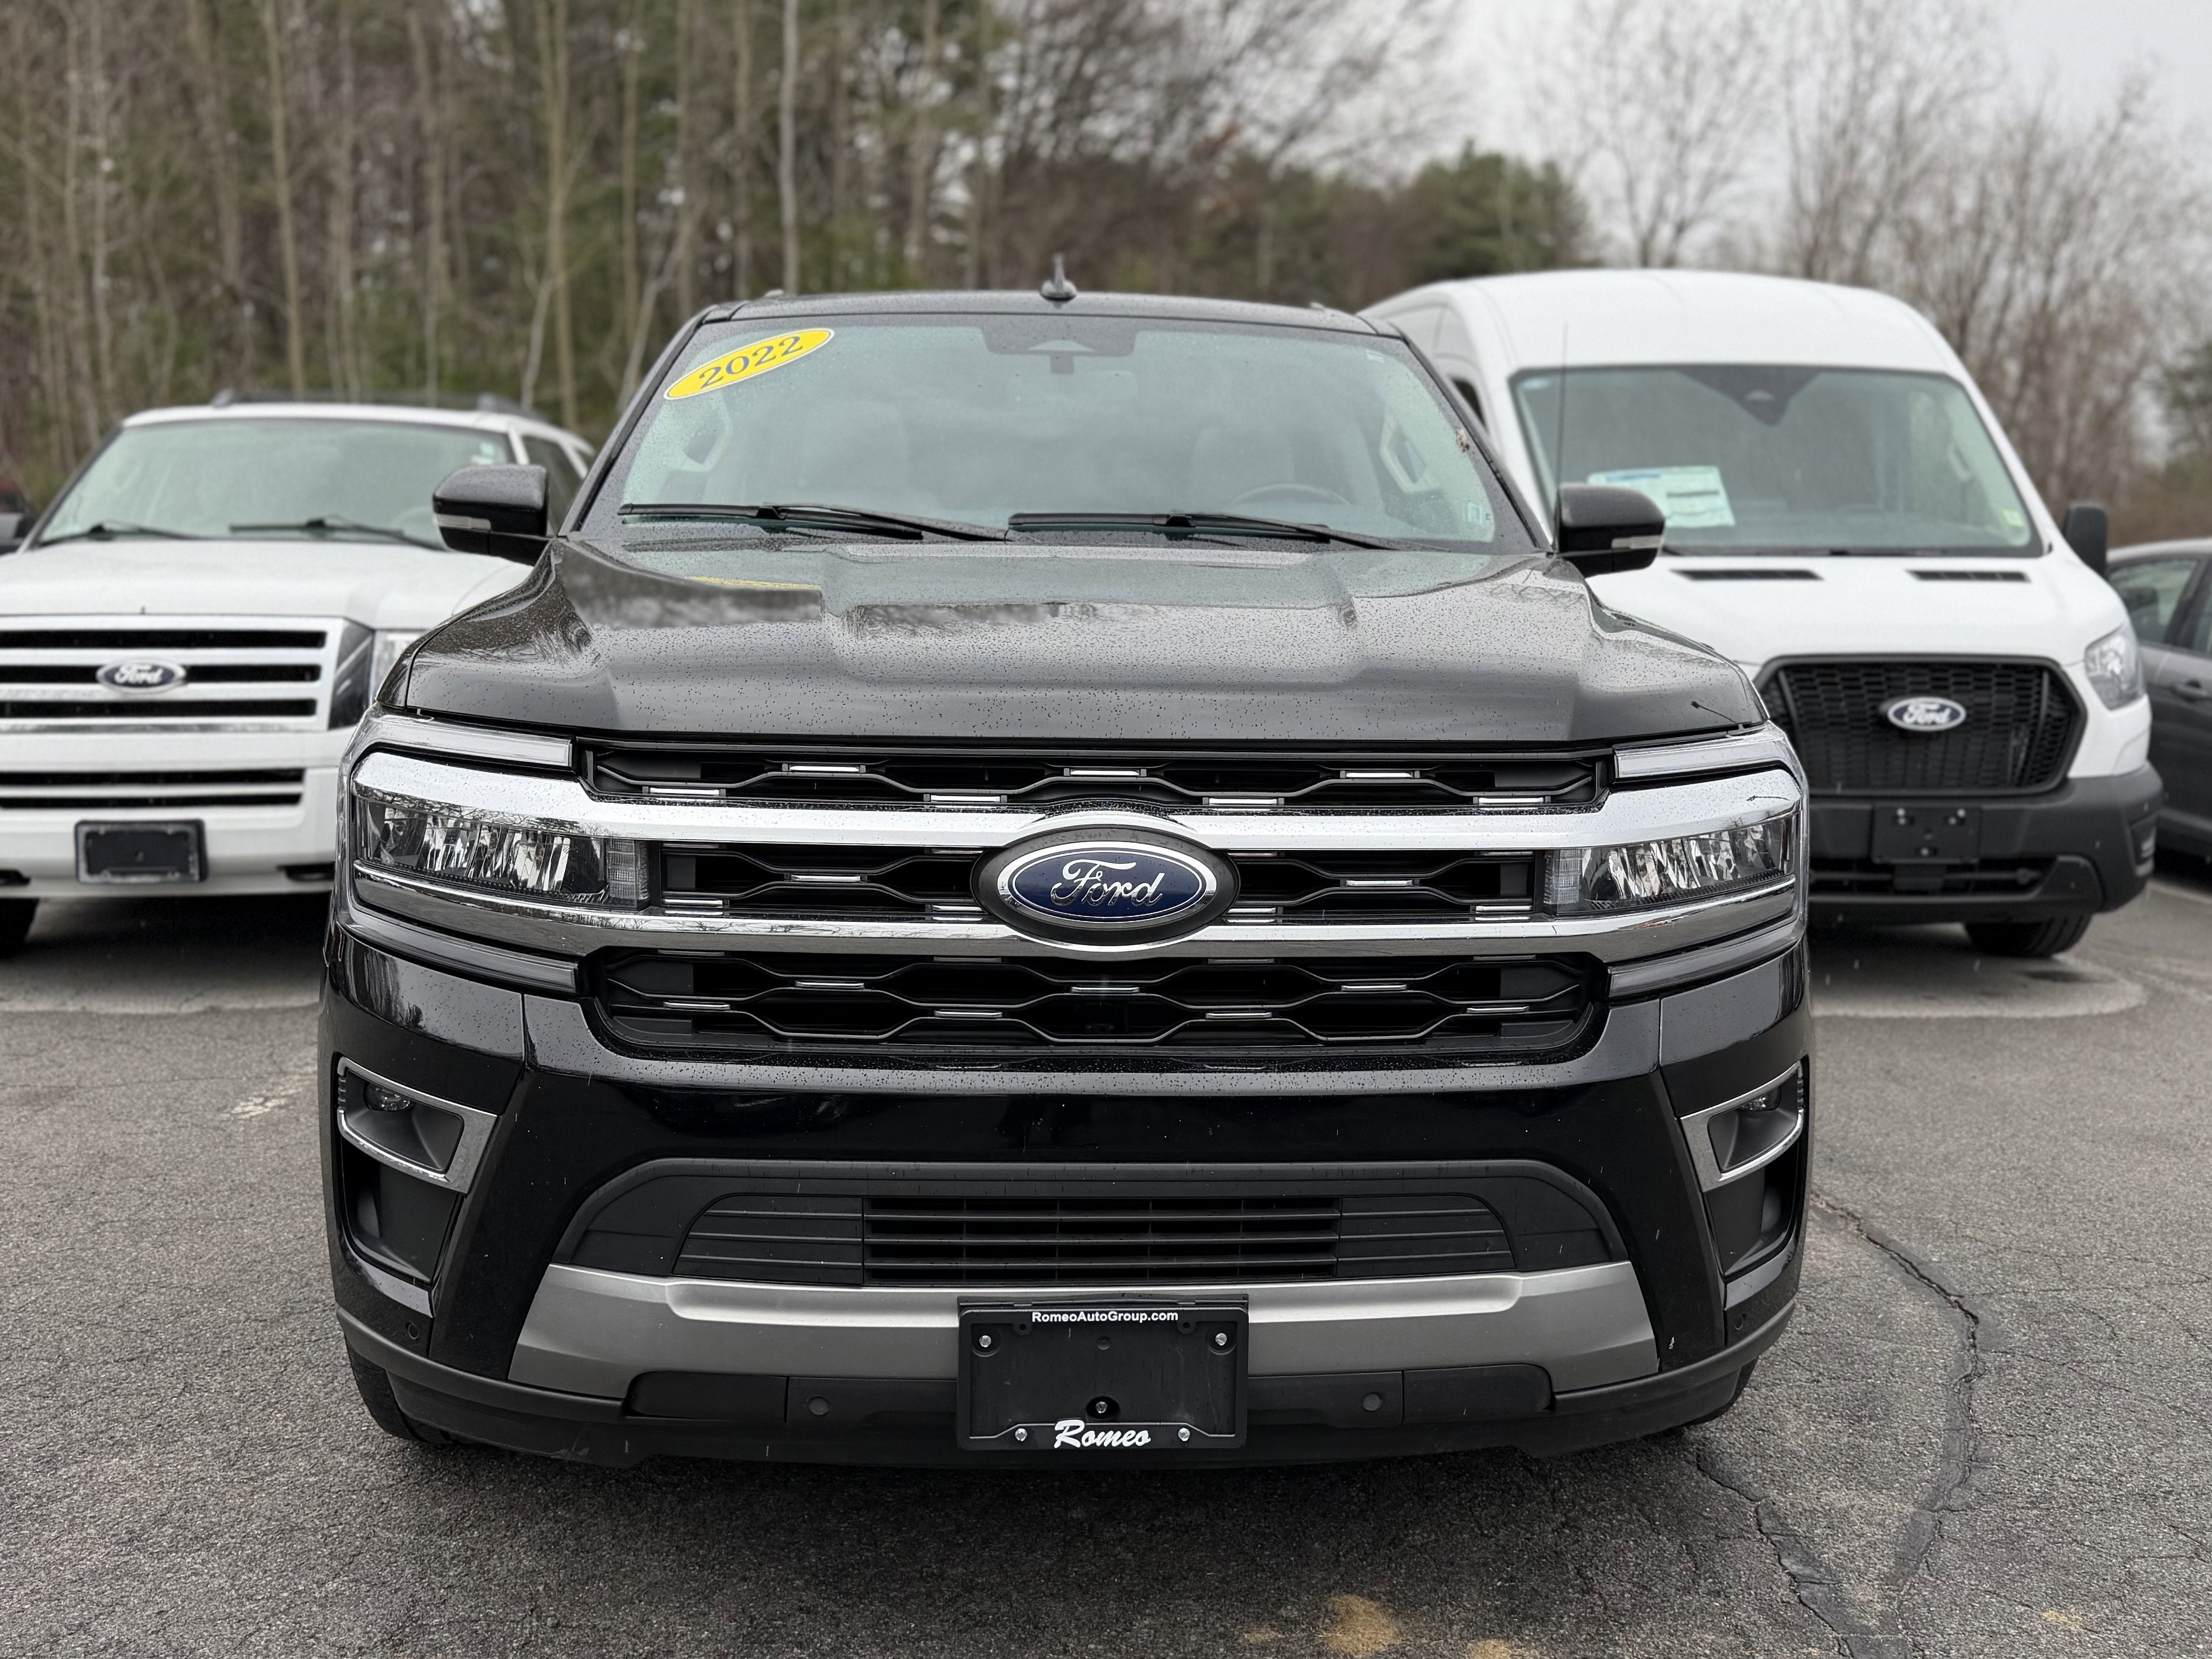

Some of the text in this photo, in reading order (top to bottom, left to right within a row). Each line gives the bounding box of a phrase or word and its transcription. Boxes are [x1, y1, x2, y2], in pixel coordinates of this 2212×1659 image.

[699, 336, 803, 389] 2022
[114, 662, 164, 685] Ford
[1902, 704, 1951, 725] Ford
[1051, 859, 1165, 906] Ford
[1032, 1311, 1178, 1323] RomeoAutoGroup.com
[1054, 1420, 1151, 1448] Romeo
